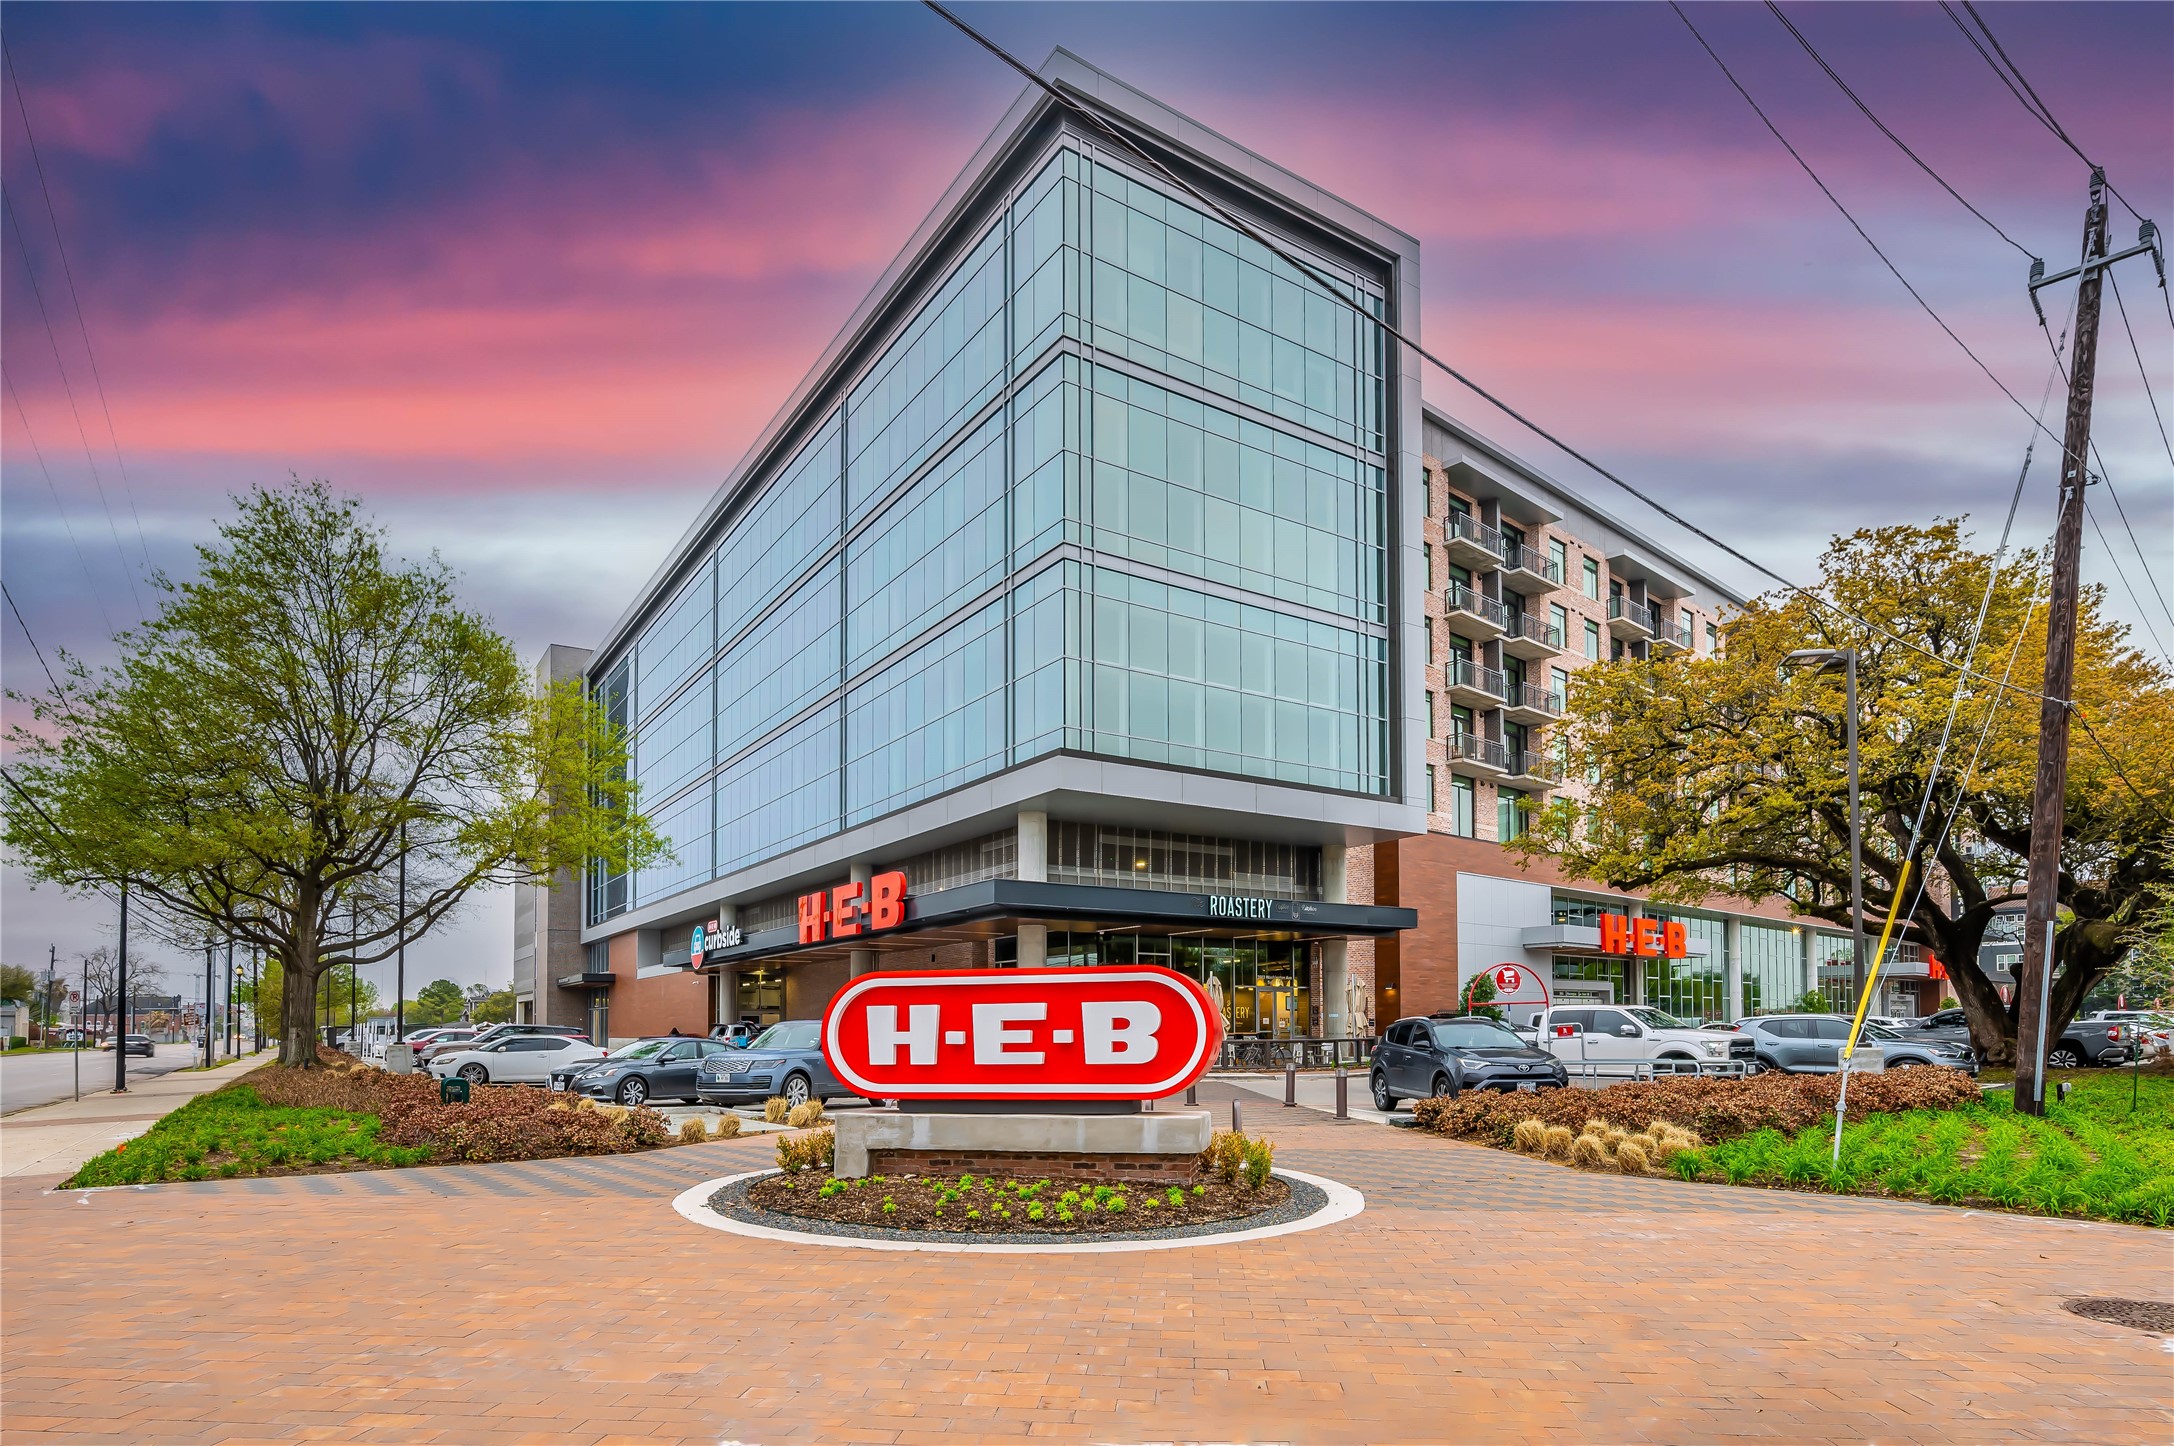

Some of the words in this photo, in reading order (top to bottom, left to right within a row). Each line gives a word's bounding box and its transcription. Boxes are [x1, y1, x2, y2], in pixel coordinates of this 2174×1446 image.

[798, 871, 907, 945] H-E-B
[1210, 895, 1273, 919] ROASTERY
[704, 924, 741, 952] curbside
[1600, 913, 1687, 958] H-E-B
[866, 1001, 1162, 1065] H-E-B
